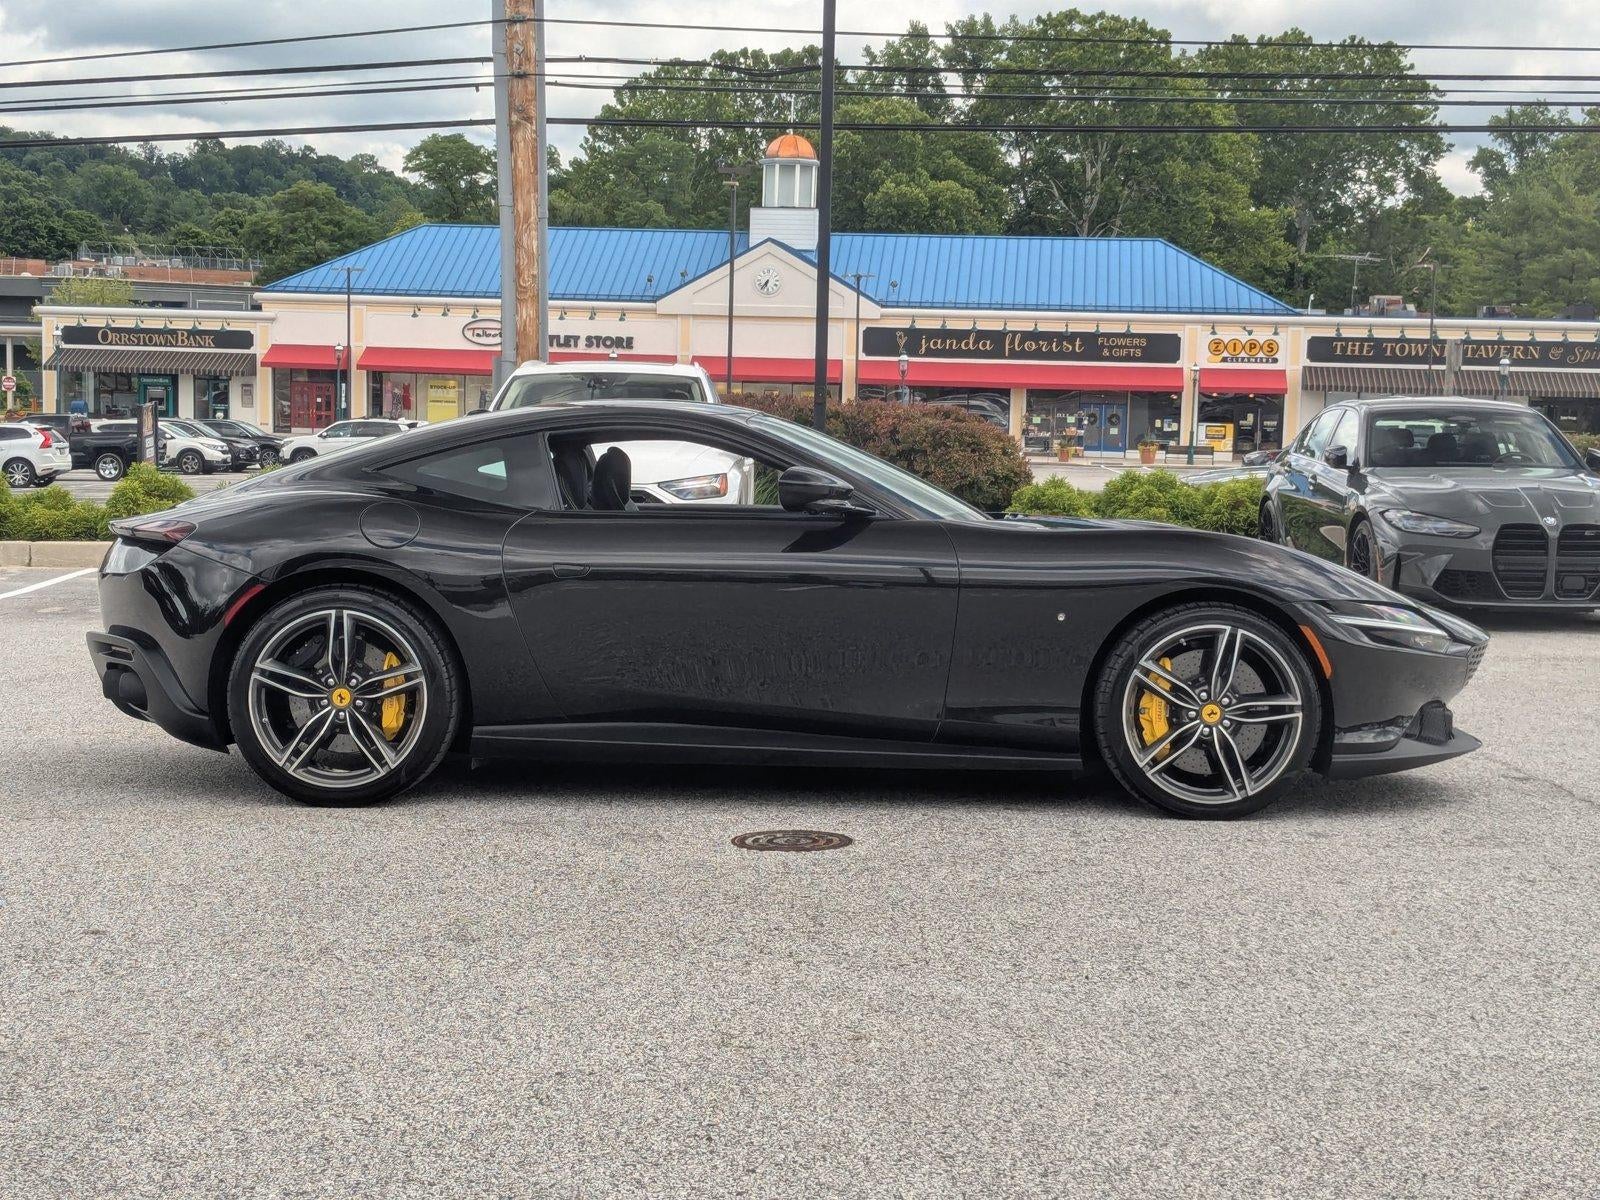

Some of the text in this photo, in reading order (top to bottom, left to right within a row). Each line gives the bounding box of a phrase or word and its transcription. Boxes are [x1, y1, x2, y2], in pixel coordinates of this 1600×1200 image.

[467, 326, 502, 338] Talbot
[548, 335, 634, 349] TLET STORE
[918, 332, 1085, 356] janda florist
[1098, 337, 1147, 347] FLOWERS
[1211, 341, 1276, 354] ZIPS
[1102, 348, 1142, 357] & GIFTS
[1332, 341, 1374, 356] THE
[1463, 344, 1541, 360] TAVERN
